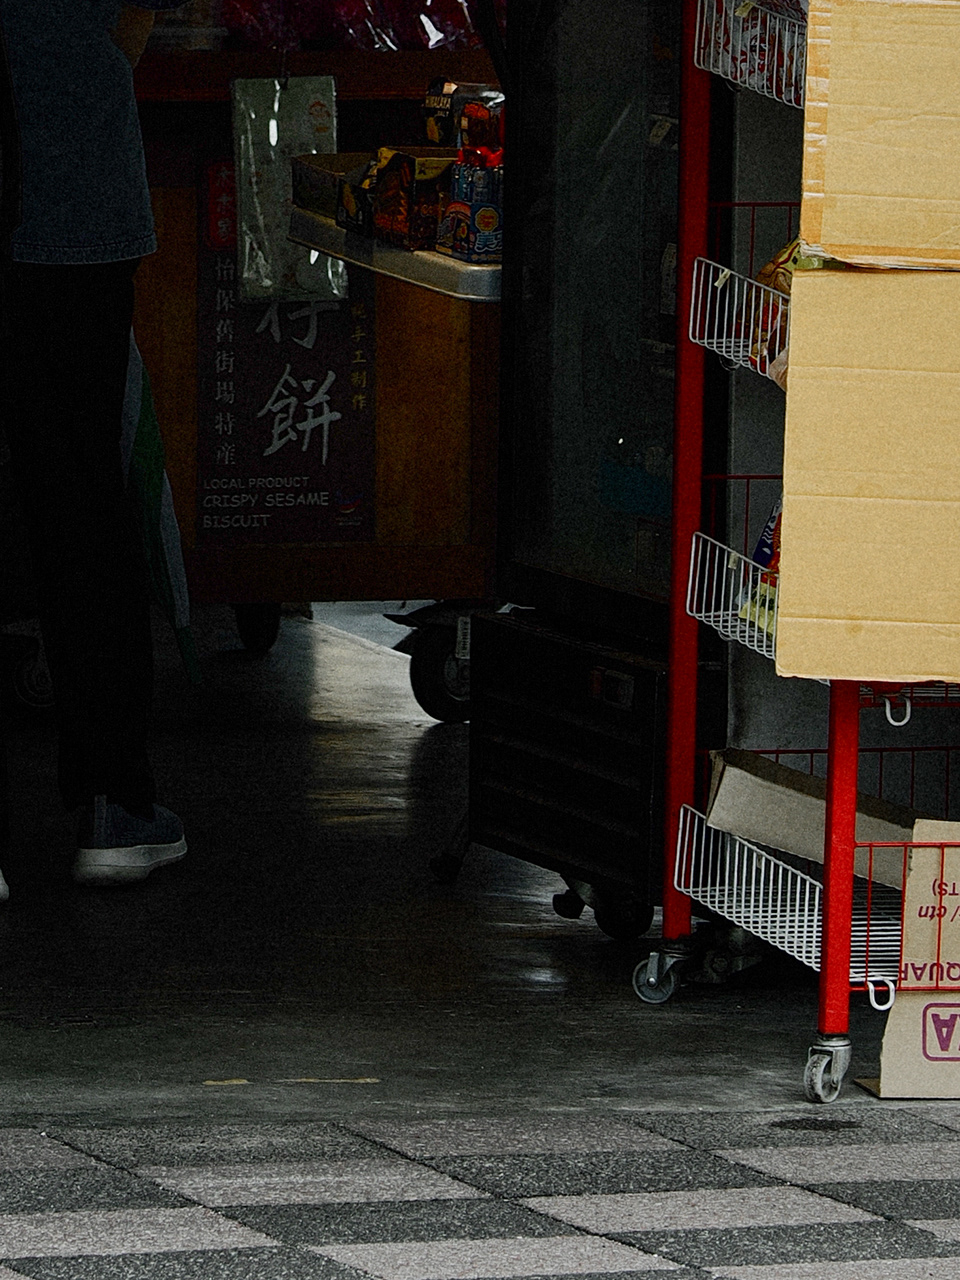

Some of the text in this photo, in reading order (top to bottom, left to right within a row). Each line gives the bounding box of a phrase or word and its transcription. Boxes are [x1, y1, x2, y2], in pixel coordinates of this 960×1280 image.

[202, 476, 311, 490] LOCAL PRODUCT
[202, 491, 330, 508] CRISPY SESAME
[202, 513, 272, 529] BISCUIT
